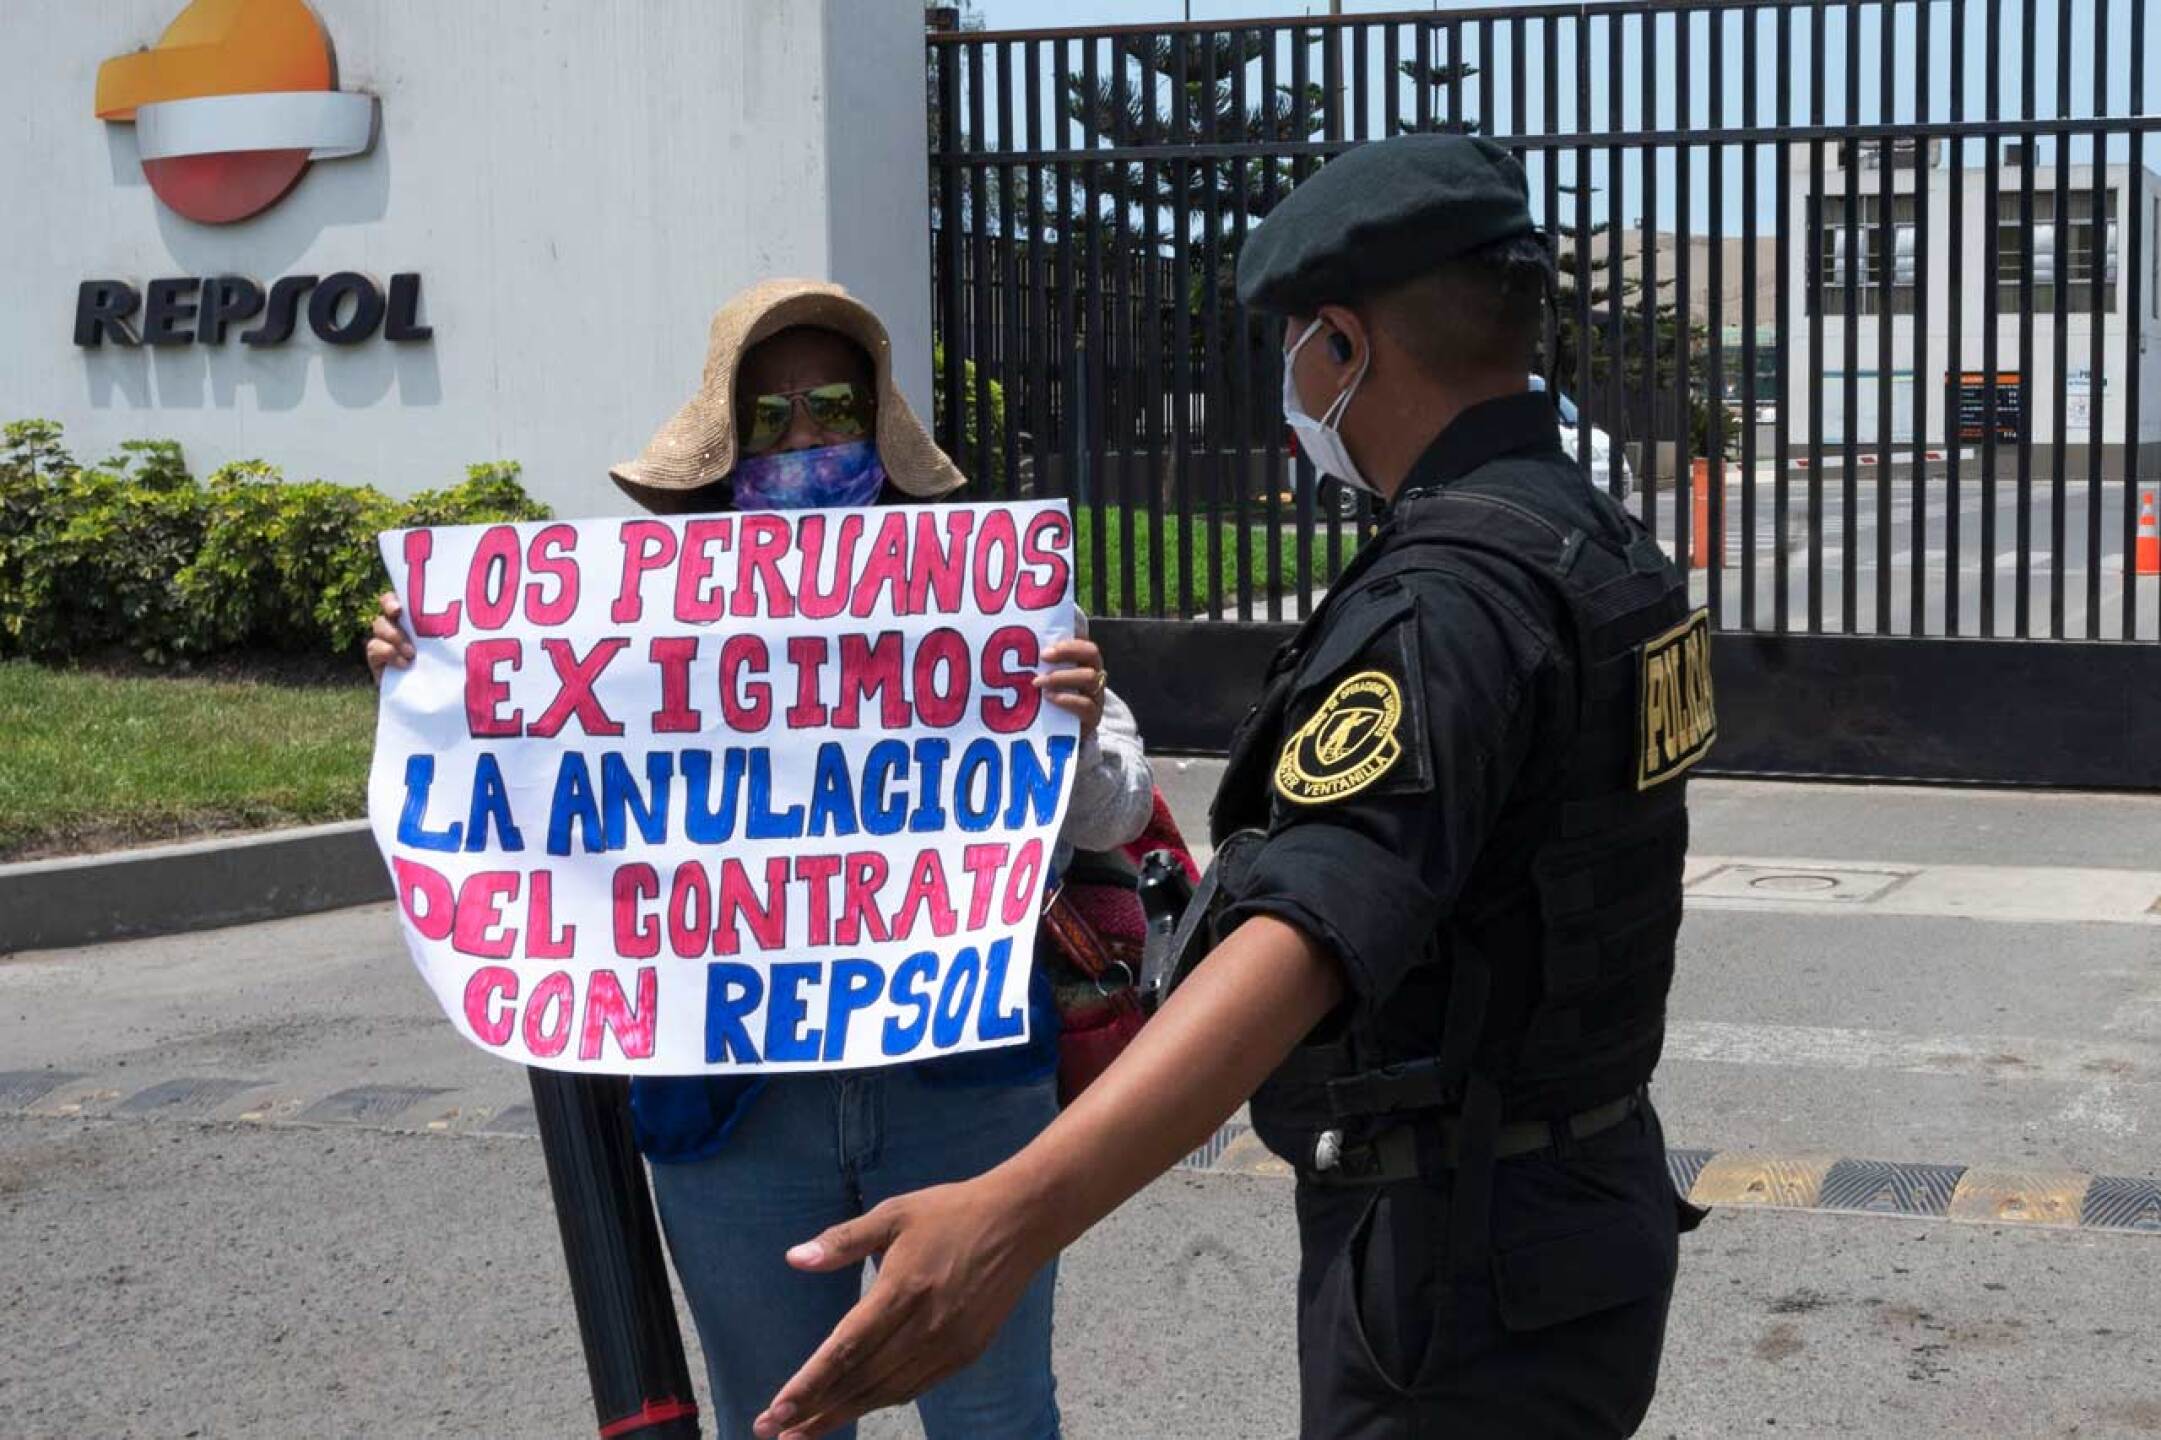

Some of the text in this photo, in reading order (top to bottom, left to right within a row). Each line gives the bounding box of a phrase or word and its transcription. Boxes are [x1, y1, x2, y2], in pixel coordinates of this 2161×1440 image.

[73, 271, 432, 346] REPSOL
[404, 510, 1070, 638] LOS PERUANOS
[465, 626, 1042, 738] EXIGIMOS
[397, 736, 1076, 855] LA ANULACION
[392, 838, 1043, 960] DEL CONTRATO
[465, 937, 1024, 1064] CON REPSOL
